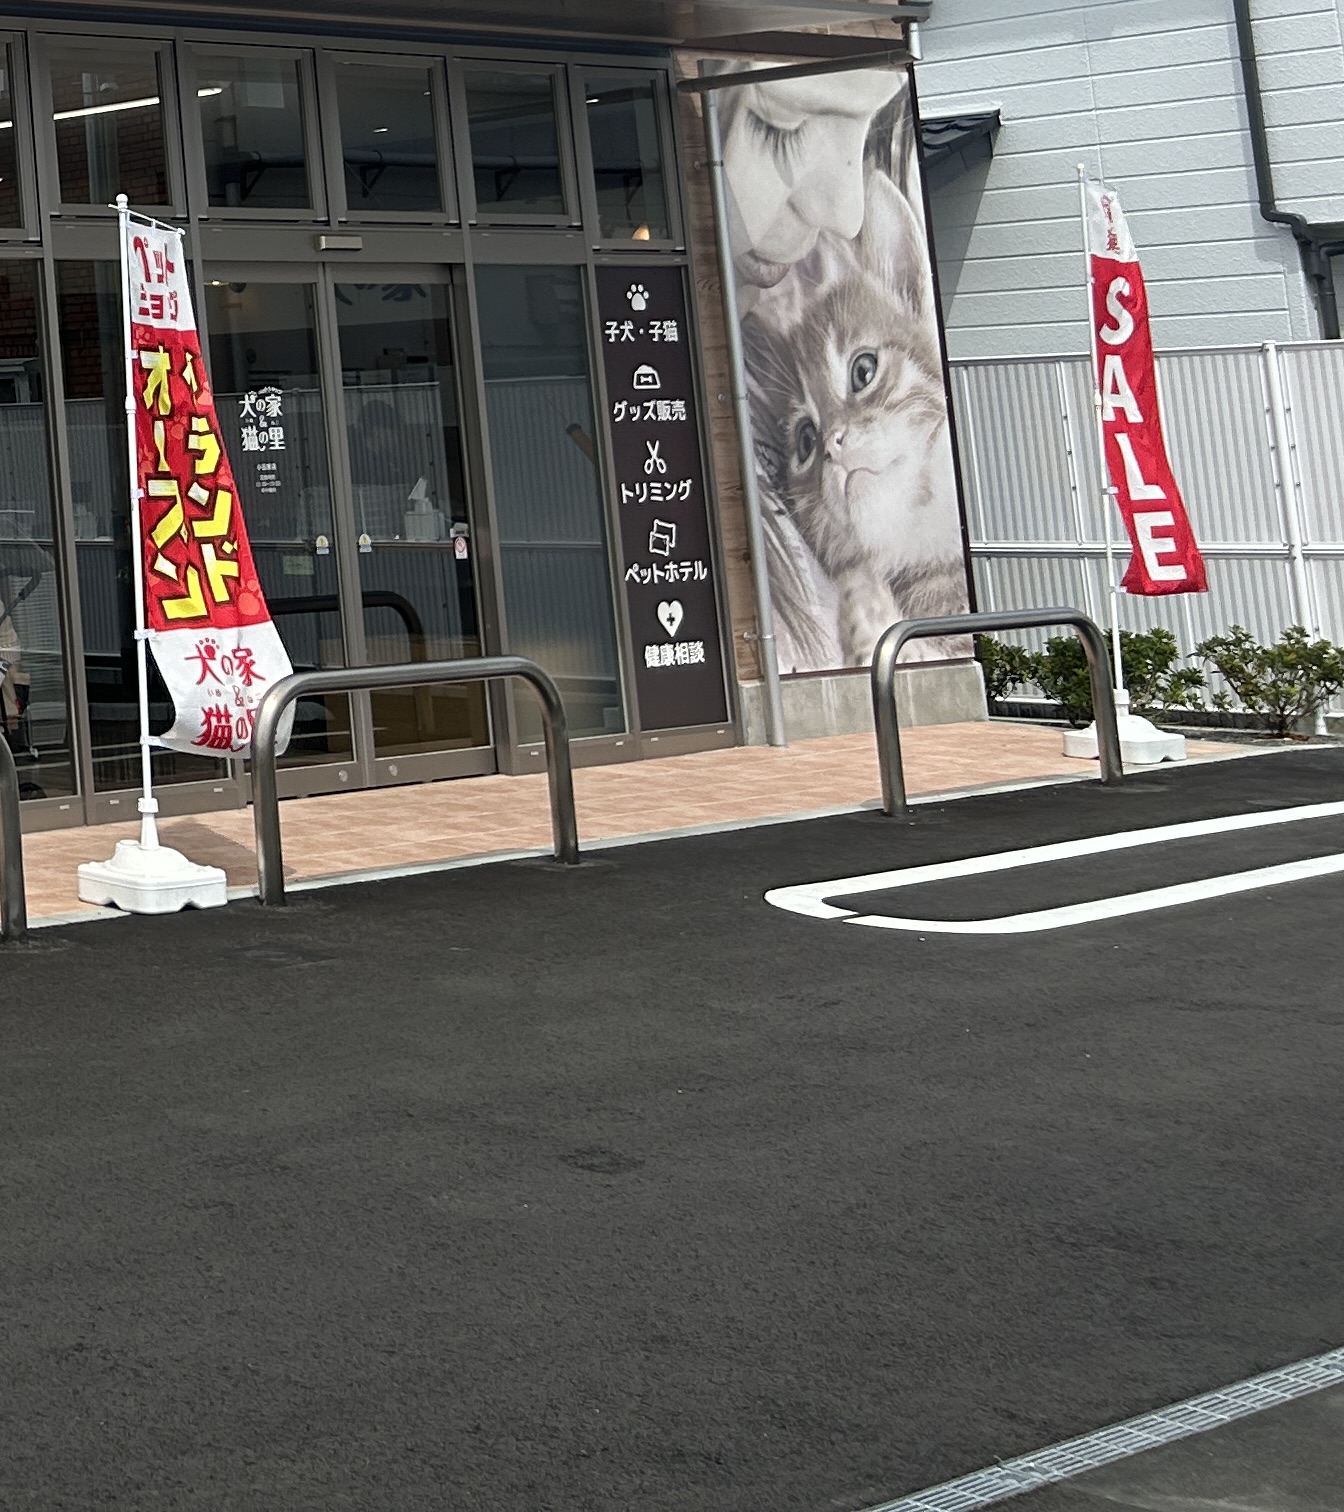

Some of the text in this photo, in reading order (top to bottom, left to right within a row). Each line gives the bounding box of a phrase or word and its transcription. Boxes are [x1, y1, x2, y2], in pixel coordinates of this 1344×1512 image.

[604, 320, 678, 344] 子犬・子猫
[238, 390, 283, 418] 犬の家
[613, 400, 686, 422] グッズ販売
[241, 425, 286, 452] 猫の里
[1098, 276, 1187, 582] SALE
[620, 478, 692, 505] トリミング
[624, 560, 707, 585] ペットホテル
[184, 637, 266, 686] 犬の家
[644, 641, 705, 669] 健康相談
[191, 703, 257, 753] 猫の
